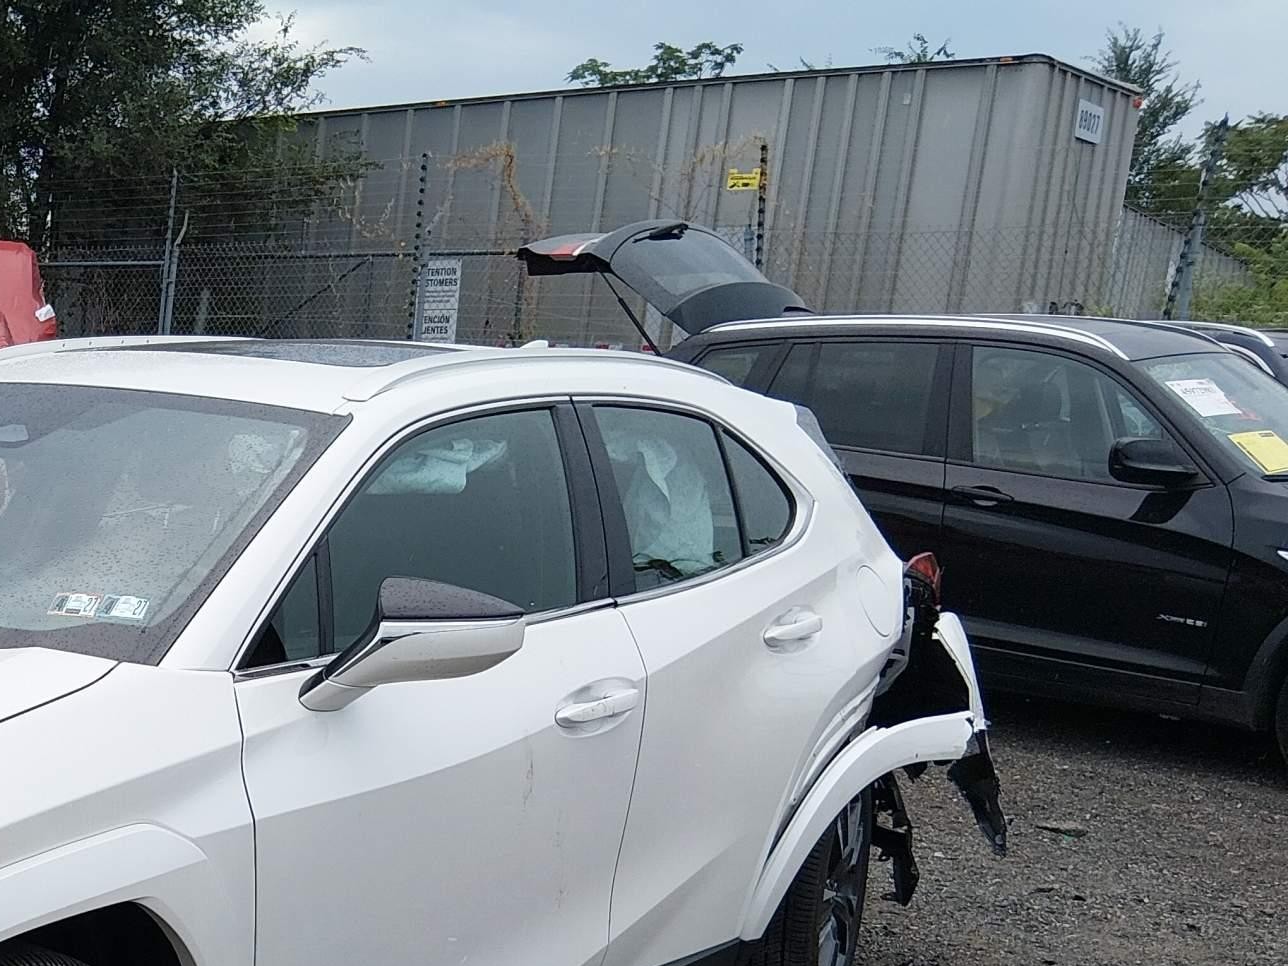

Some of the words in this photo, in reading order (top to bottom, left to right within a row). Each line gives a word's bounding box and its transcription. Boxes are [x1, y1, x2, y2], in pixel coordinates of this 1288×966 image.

[427, 267, 457, 277] TENTION
[425, 278, 458, 288] STOMERS
[423, 314, 450, 324] ENCIÓN
[132, 600, 149, 616] 27
